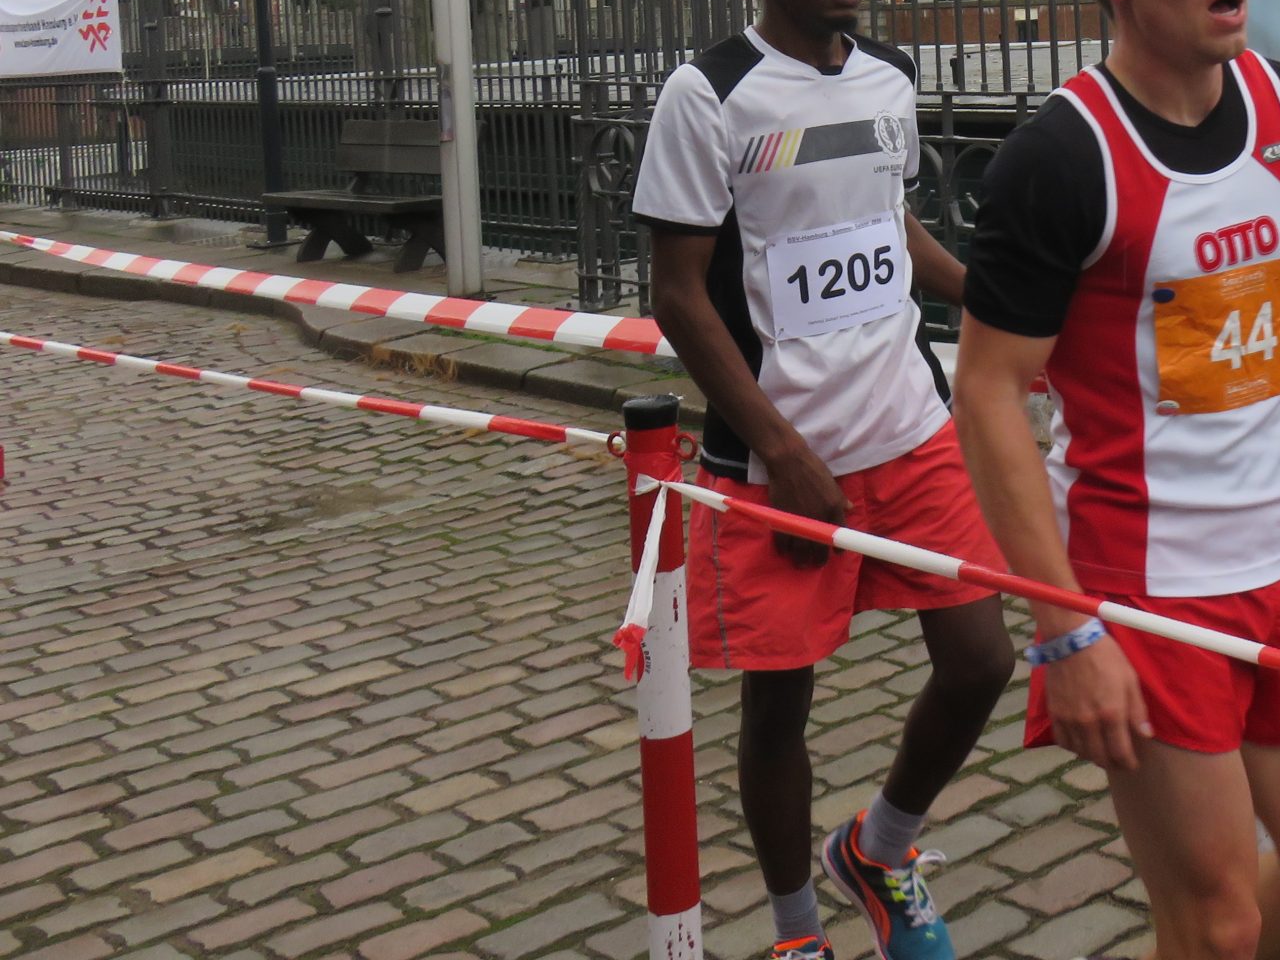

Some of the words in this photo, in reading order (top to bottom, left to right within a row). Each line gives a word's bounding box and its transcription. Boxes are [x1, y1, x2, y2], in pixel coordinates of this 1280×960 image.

[1194, 215, 1280, 273] OTTO
[786, 245, 895, 304] 1205
[1210, 300, 1278, 371] 44
